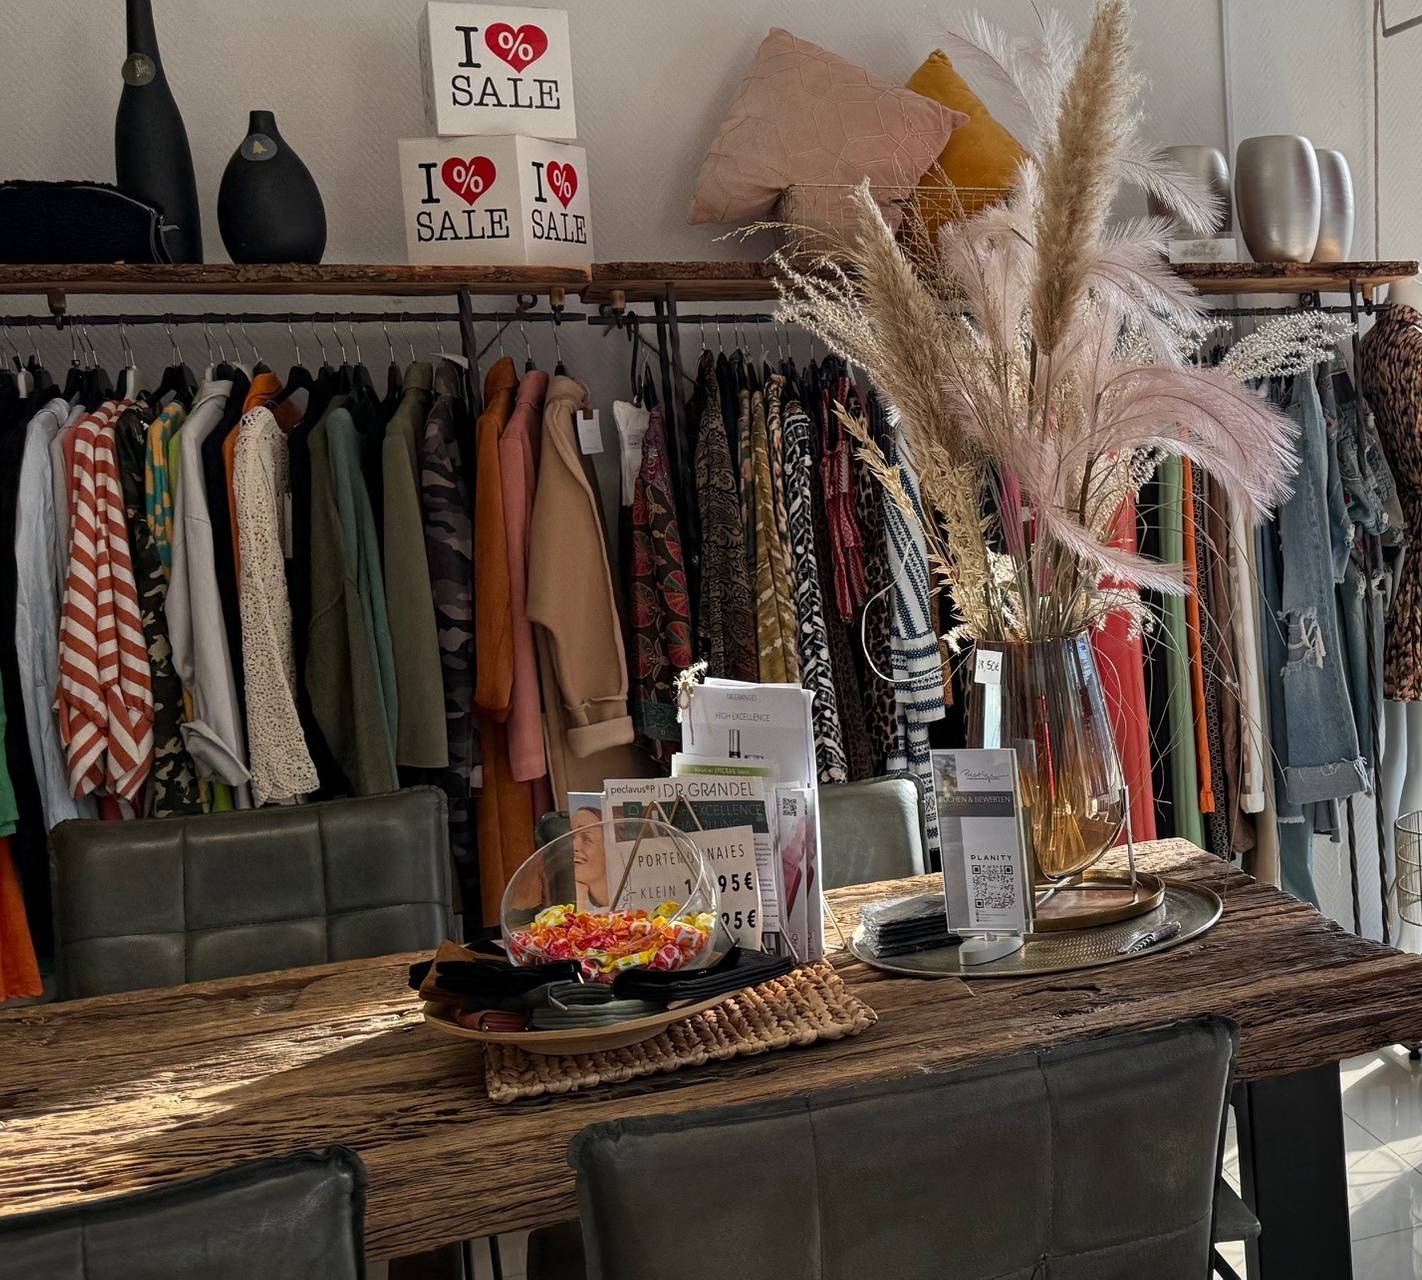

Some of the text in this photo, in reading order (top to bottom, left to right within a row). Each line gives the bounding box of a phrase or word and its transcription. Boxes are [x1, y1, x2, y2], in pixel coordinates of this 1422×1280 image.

[455, 26, 482, 69] I
[451, 74, 561, 110] SALE
[418, 162, 440, 204] I
[531, 161, 547, 203] I
[416, 208, 510, 242] SALE
[531, 208, 587, 245] SALE
[663, 781, 755, 798] DR.GRANDEL
[638, 843, 745, 868] PORTEMONAIES
[640, 885, 676, 899] KLEIN
